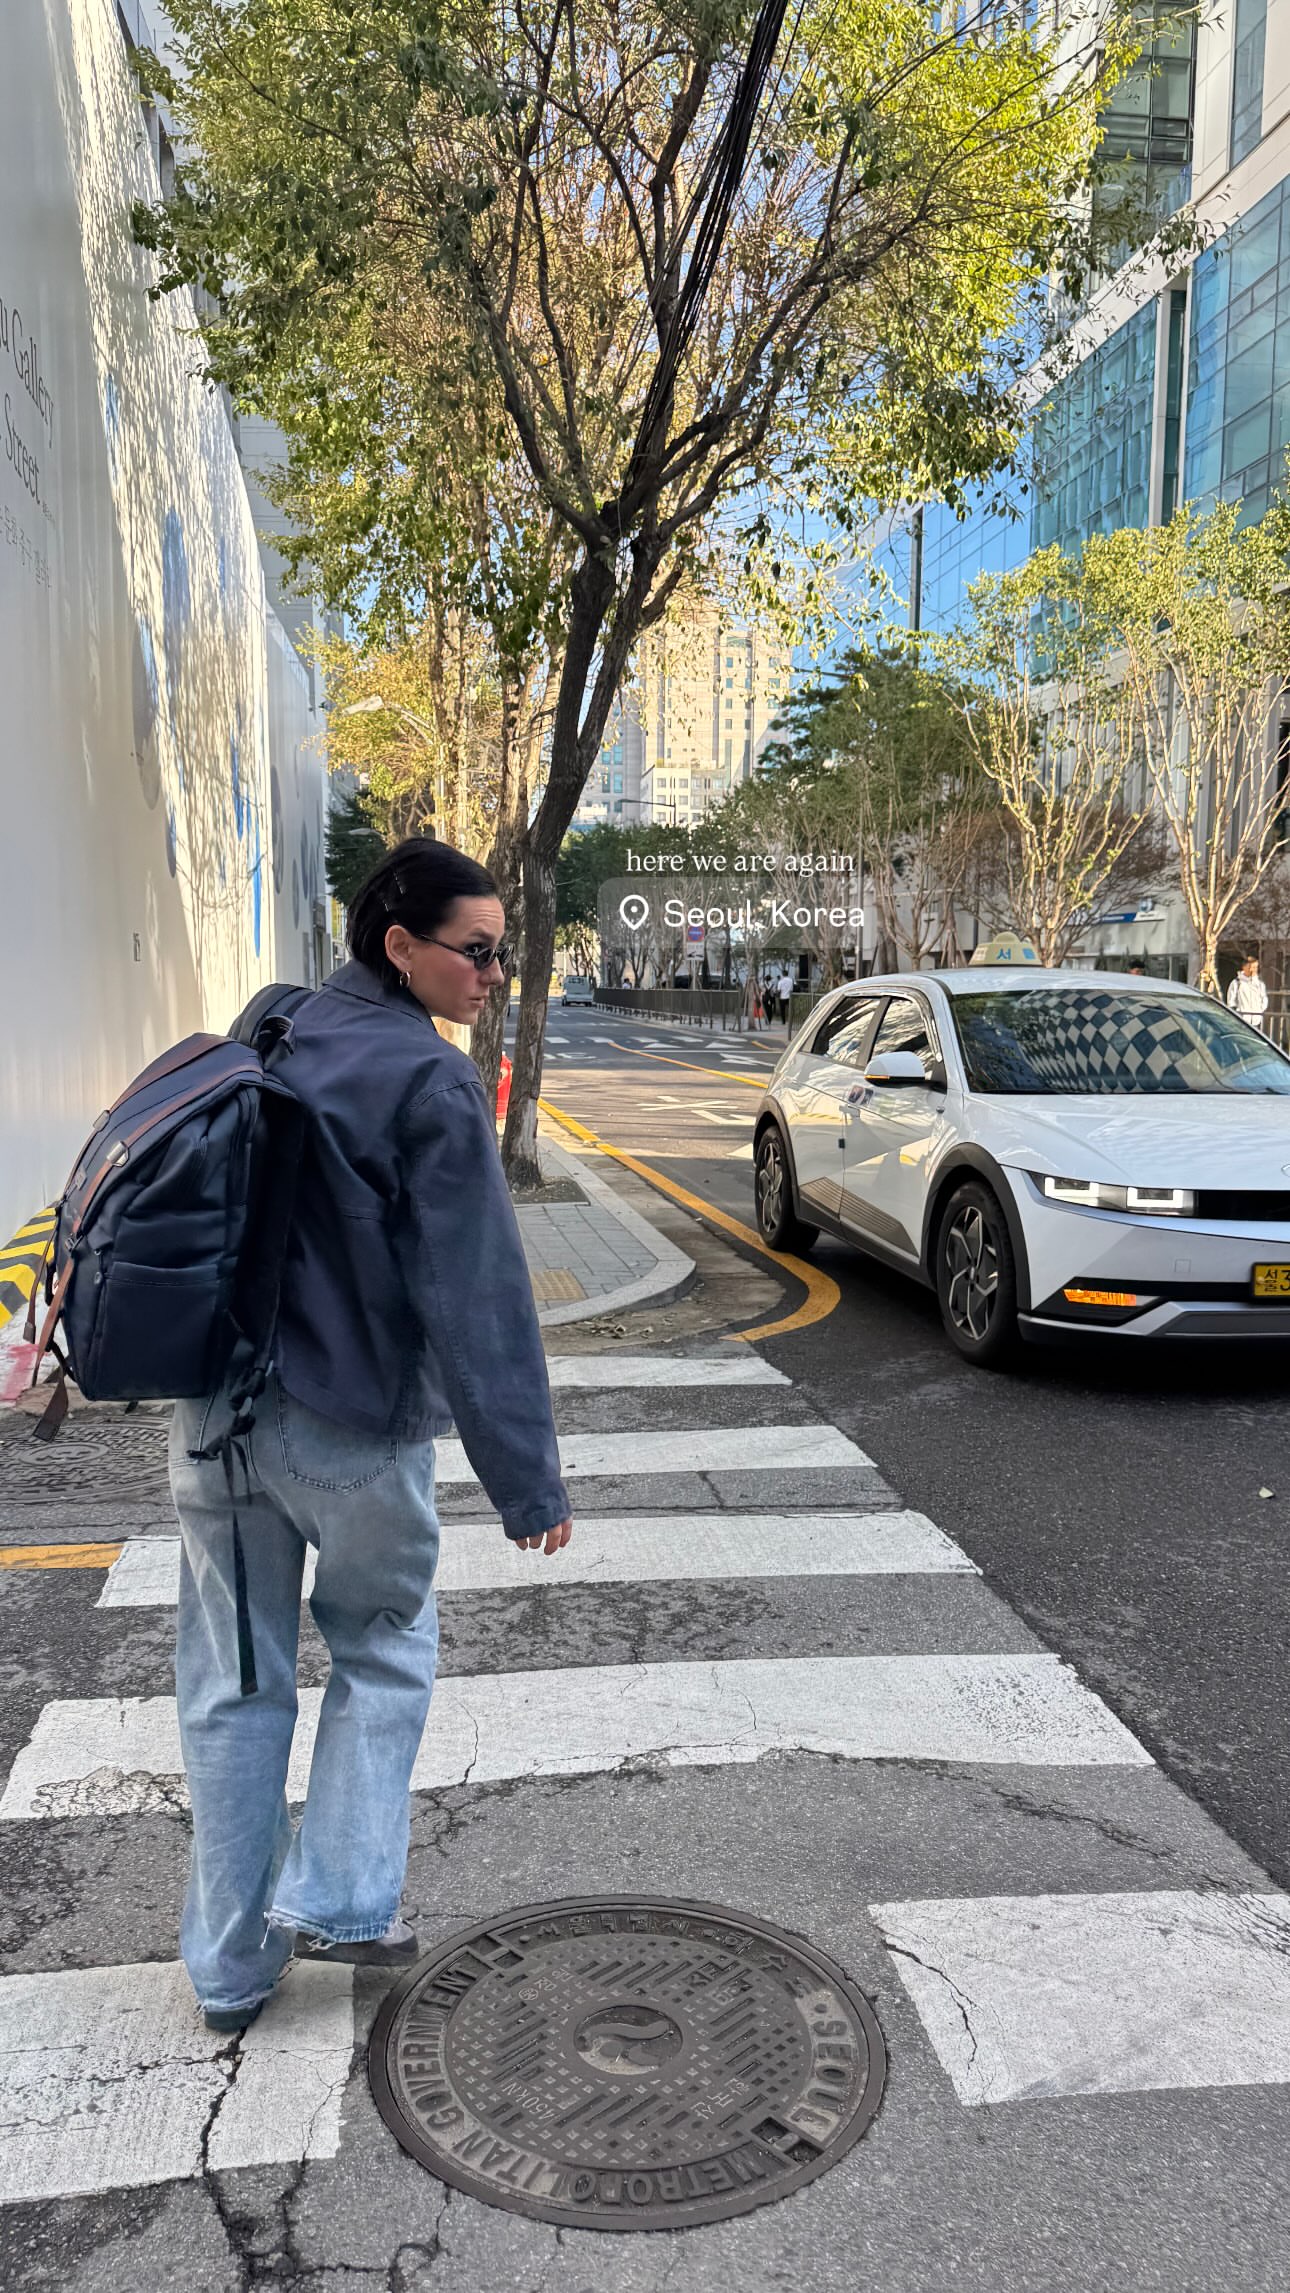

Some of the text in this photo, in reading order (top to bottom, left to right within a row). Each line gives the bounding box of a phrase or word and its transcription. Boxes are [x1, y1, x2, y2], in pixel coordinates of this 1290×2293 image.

[12, 308, 54, 449] Gallery
[4, 392, 40, 505] Street
[537, 1911, 691, 1936] 서울특별시
[403, 1961, 847, 2202] SEOUL METROPOLITAN GOVERNMENT
[502, 2080, 557, 2121] 450kN
